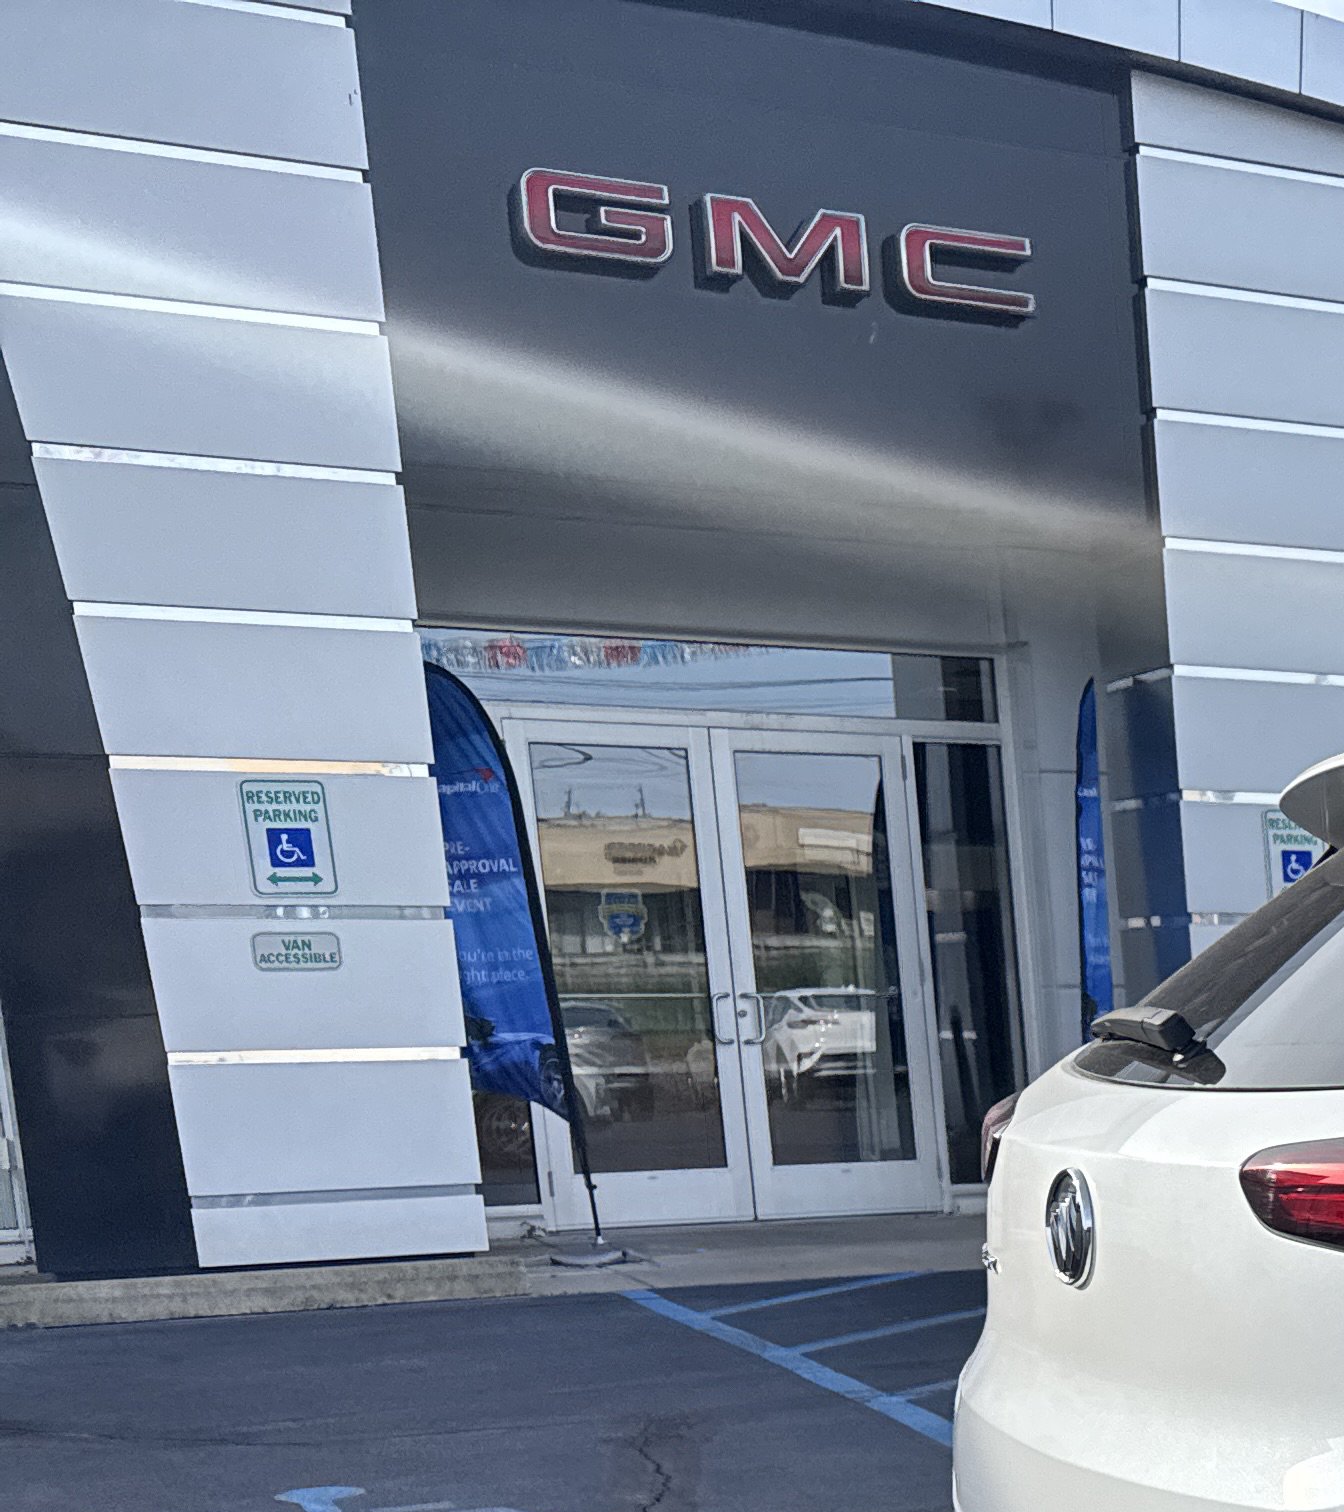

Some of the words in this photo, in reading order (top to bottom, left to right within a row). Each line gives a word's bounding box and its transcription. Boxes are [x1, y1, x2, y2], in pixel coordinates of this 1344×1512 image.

[518, 166, 1037, 318] GMC
[245, 790, 321, 805] RESERVED
[253, 808, 319, 823] PARKING
[281, 939, 312, 952] VAN
[259, 952, 338, 965] ACCESSIBLE
